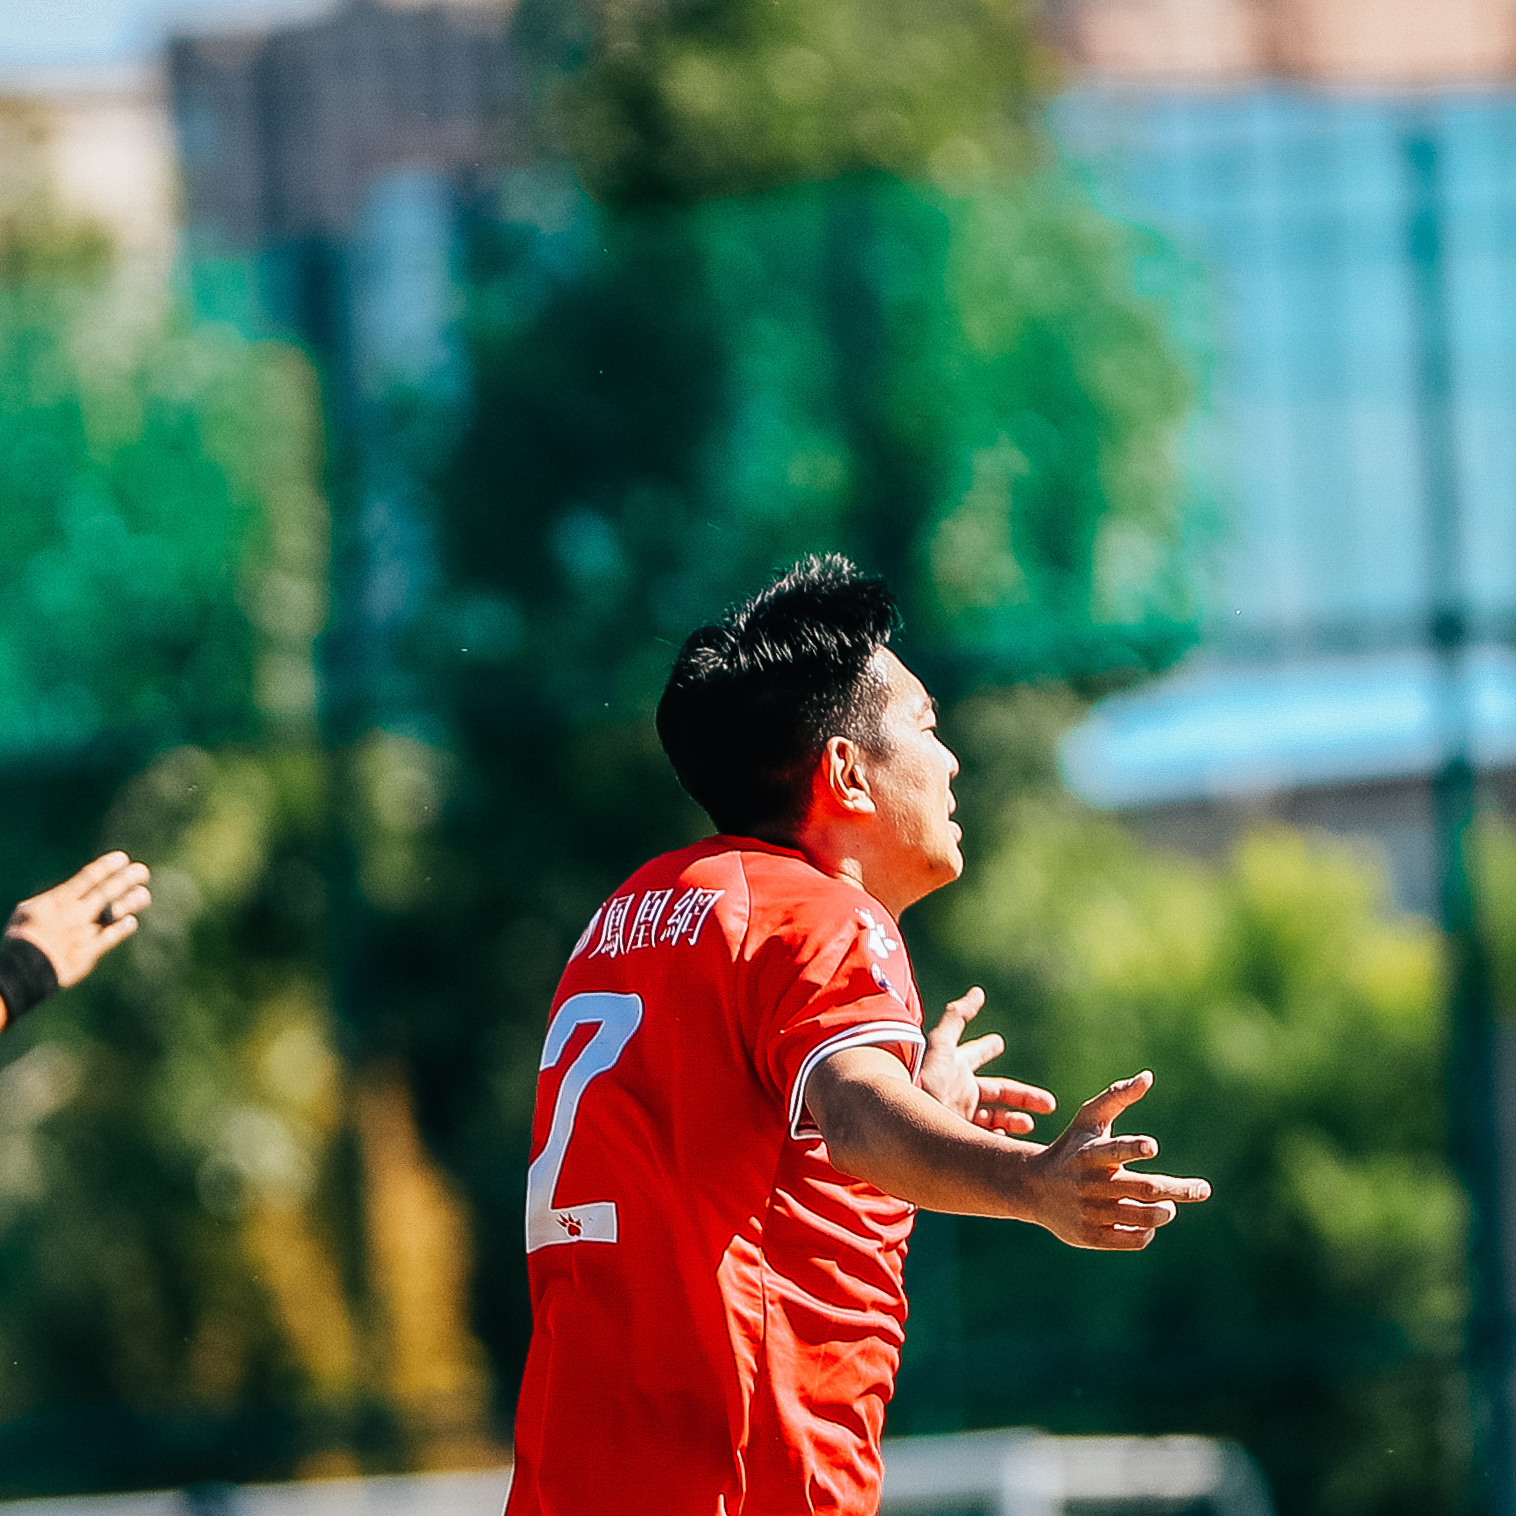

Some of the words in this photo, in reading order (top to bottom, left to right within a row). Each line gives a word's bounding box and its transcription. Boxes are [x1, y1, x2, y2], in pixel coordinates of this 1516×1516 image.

[588, 888, 725, 959] 鳳凰網
[526, 993, 642, 1254] 2
